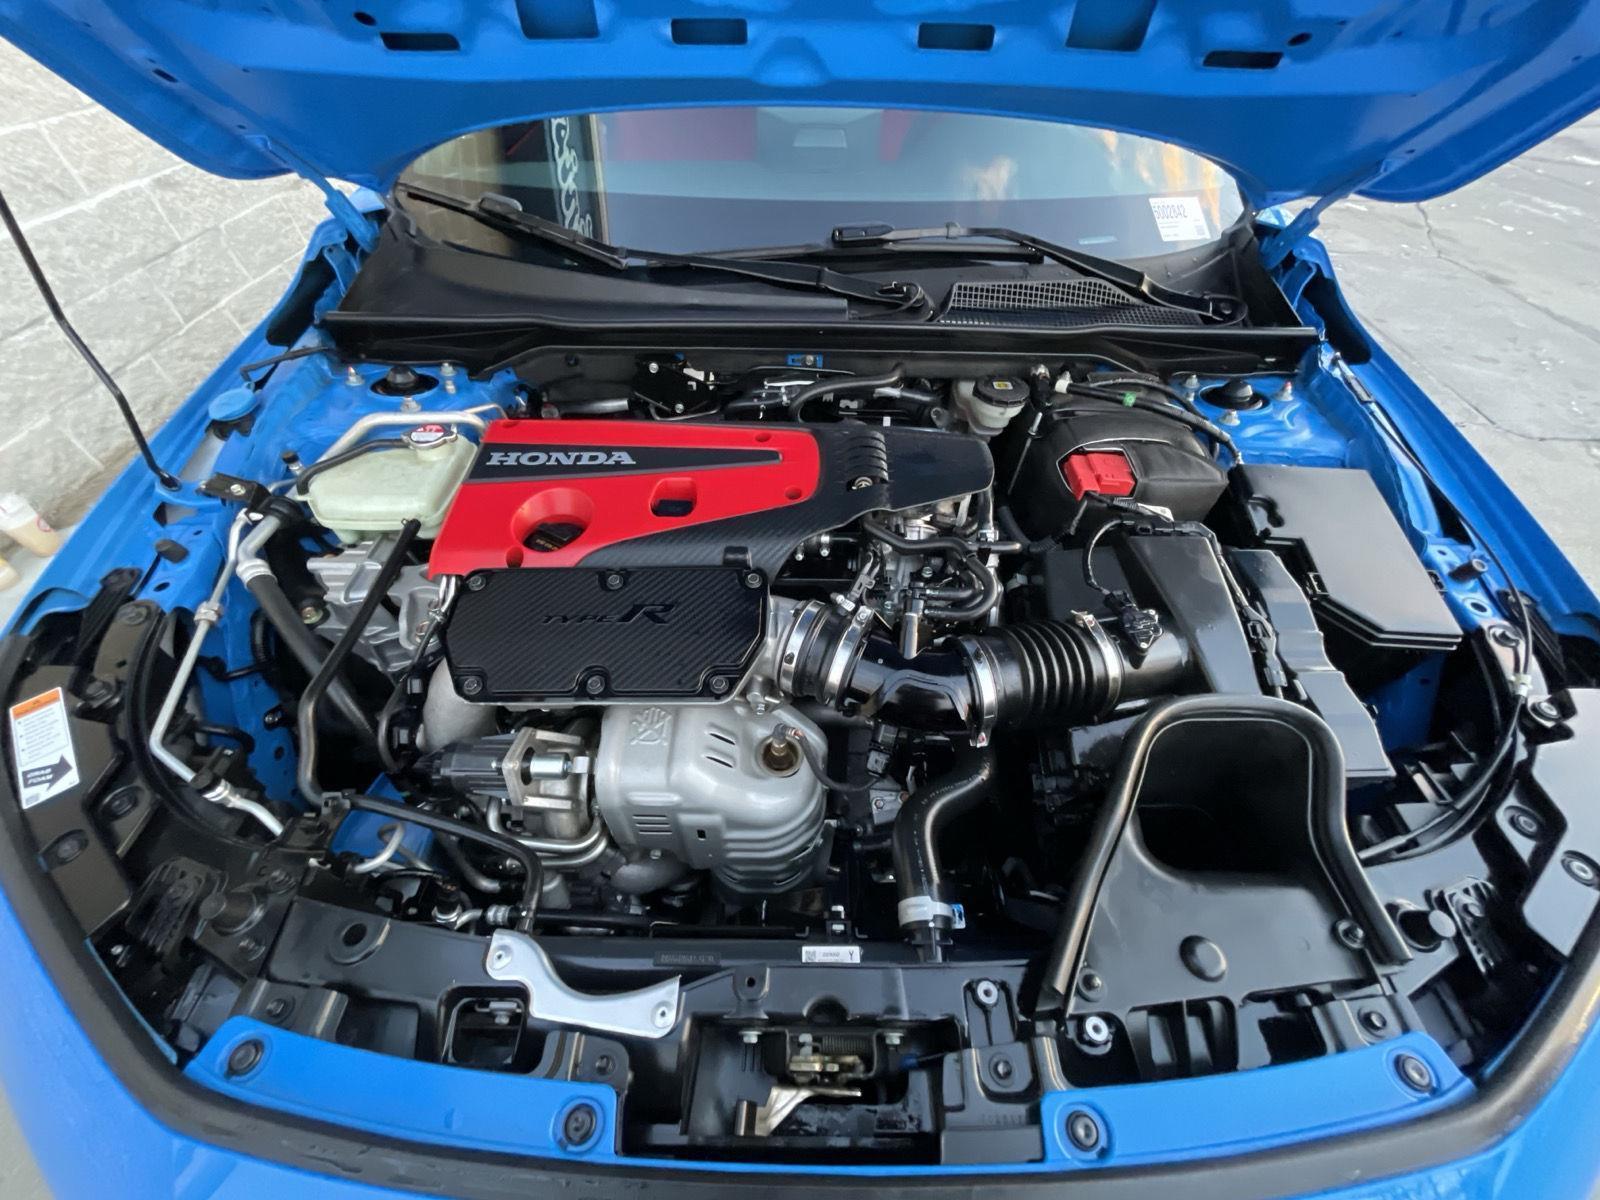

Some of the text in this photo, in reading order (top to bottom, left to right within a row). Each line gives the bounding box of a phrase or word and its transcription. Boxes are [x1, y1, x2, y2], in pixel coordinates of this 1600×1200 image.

[486, 451, 637, 466] HONDA
[616, 603, 676, 625] R
[848, 949, 855, 961] Y
